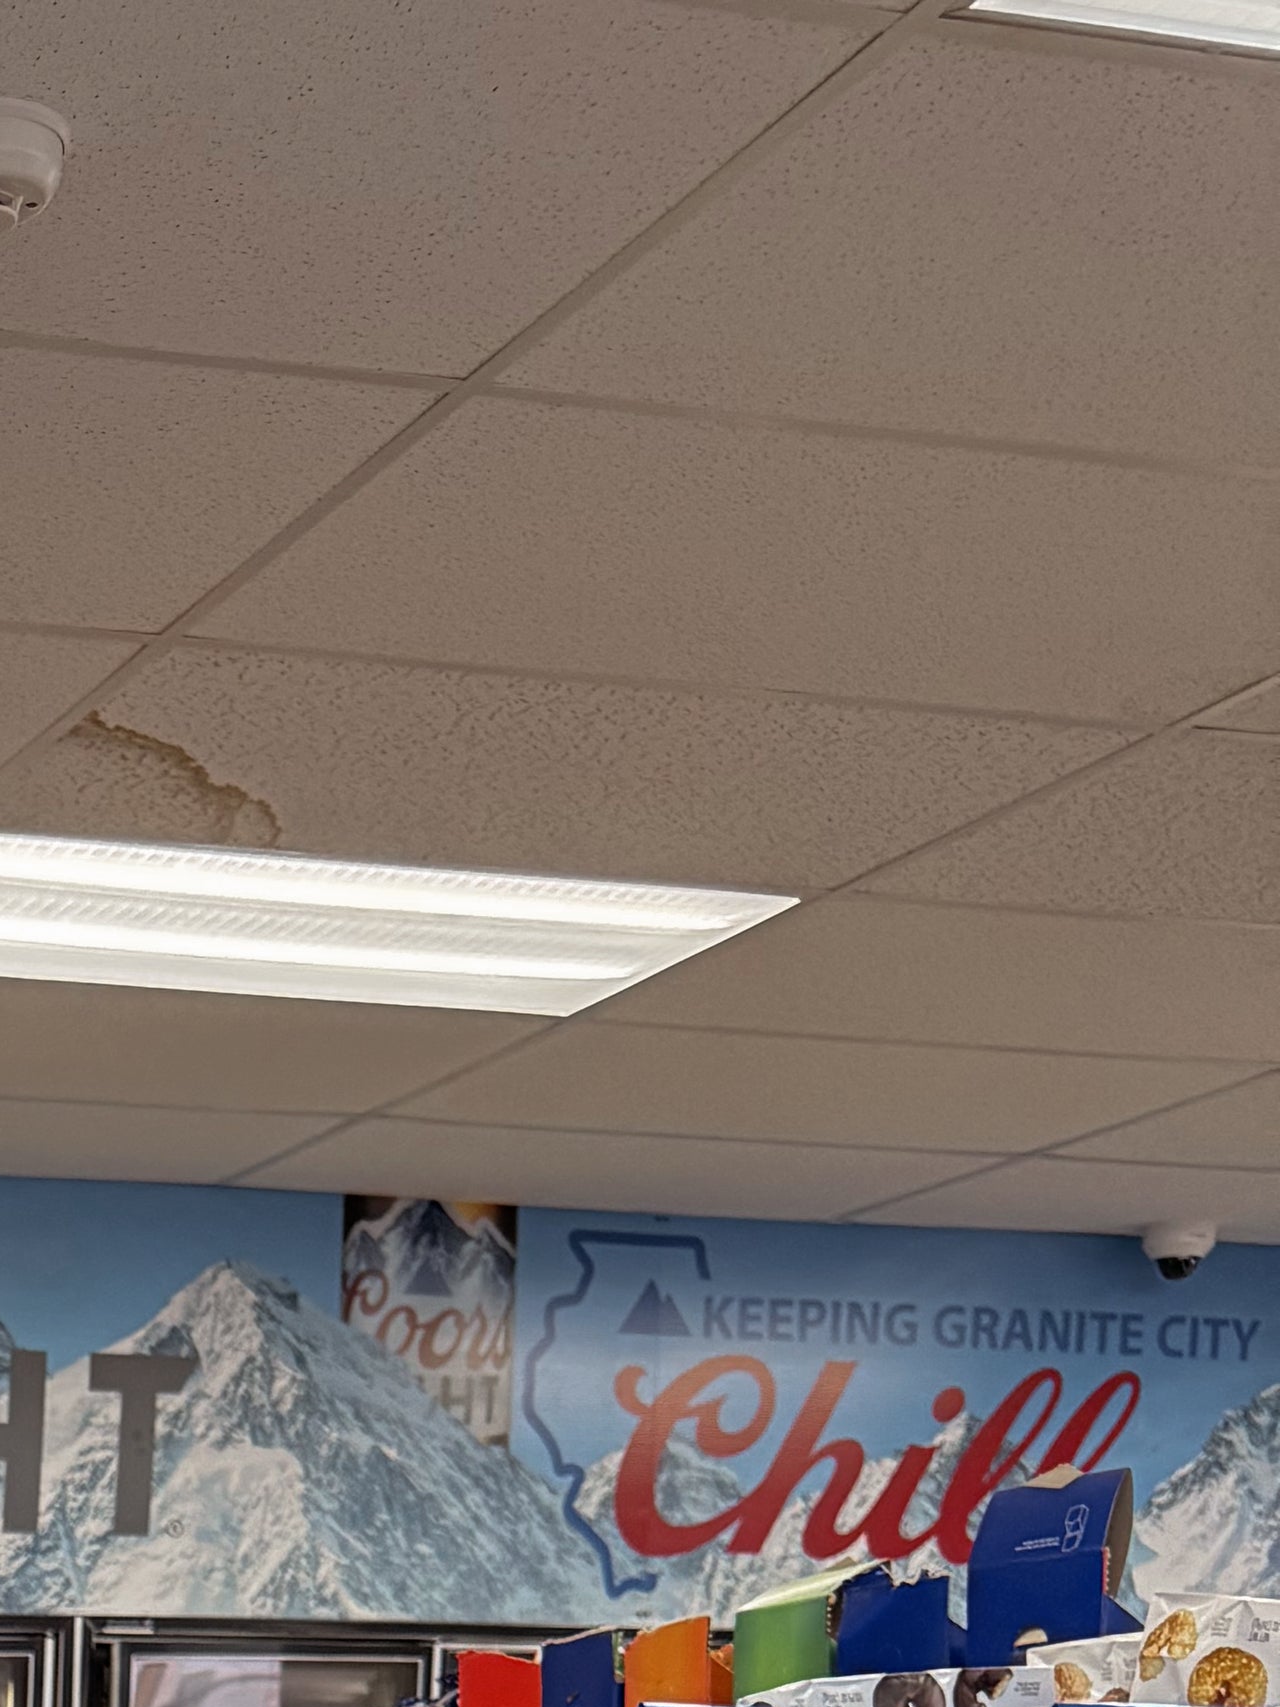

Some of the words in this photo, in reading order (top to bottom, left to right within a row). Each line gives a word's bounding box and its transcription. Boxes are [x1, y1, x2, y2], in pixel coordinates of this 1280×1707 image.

[702, 1294, 919, 1346] KEEPING
[935, 1302, 1144, 1356] GRANITE
[1156, 1312, 1261, 1362] CITY
[613, 1353, 1141, 1565] Chill
